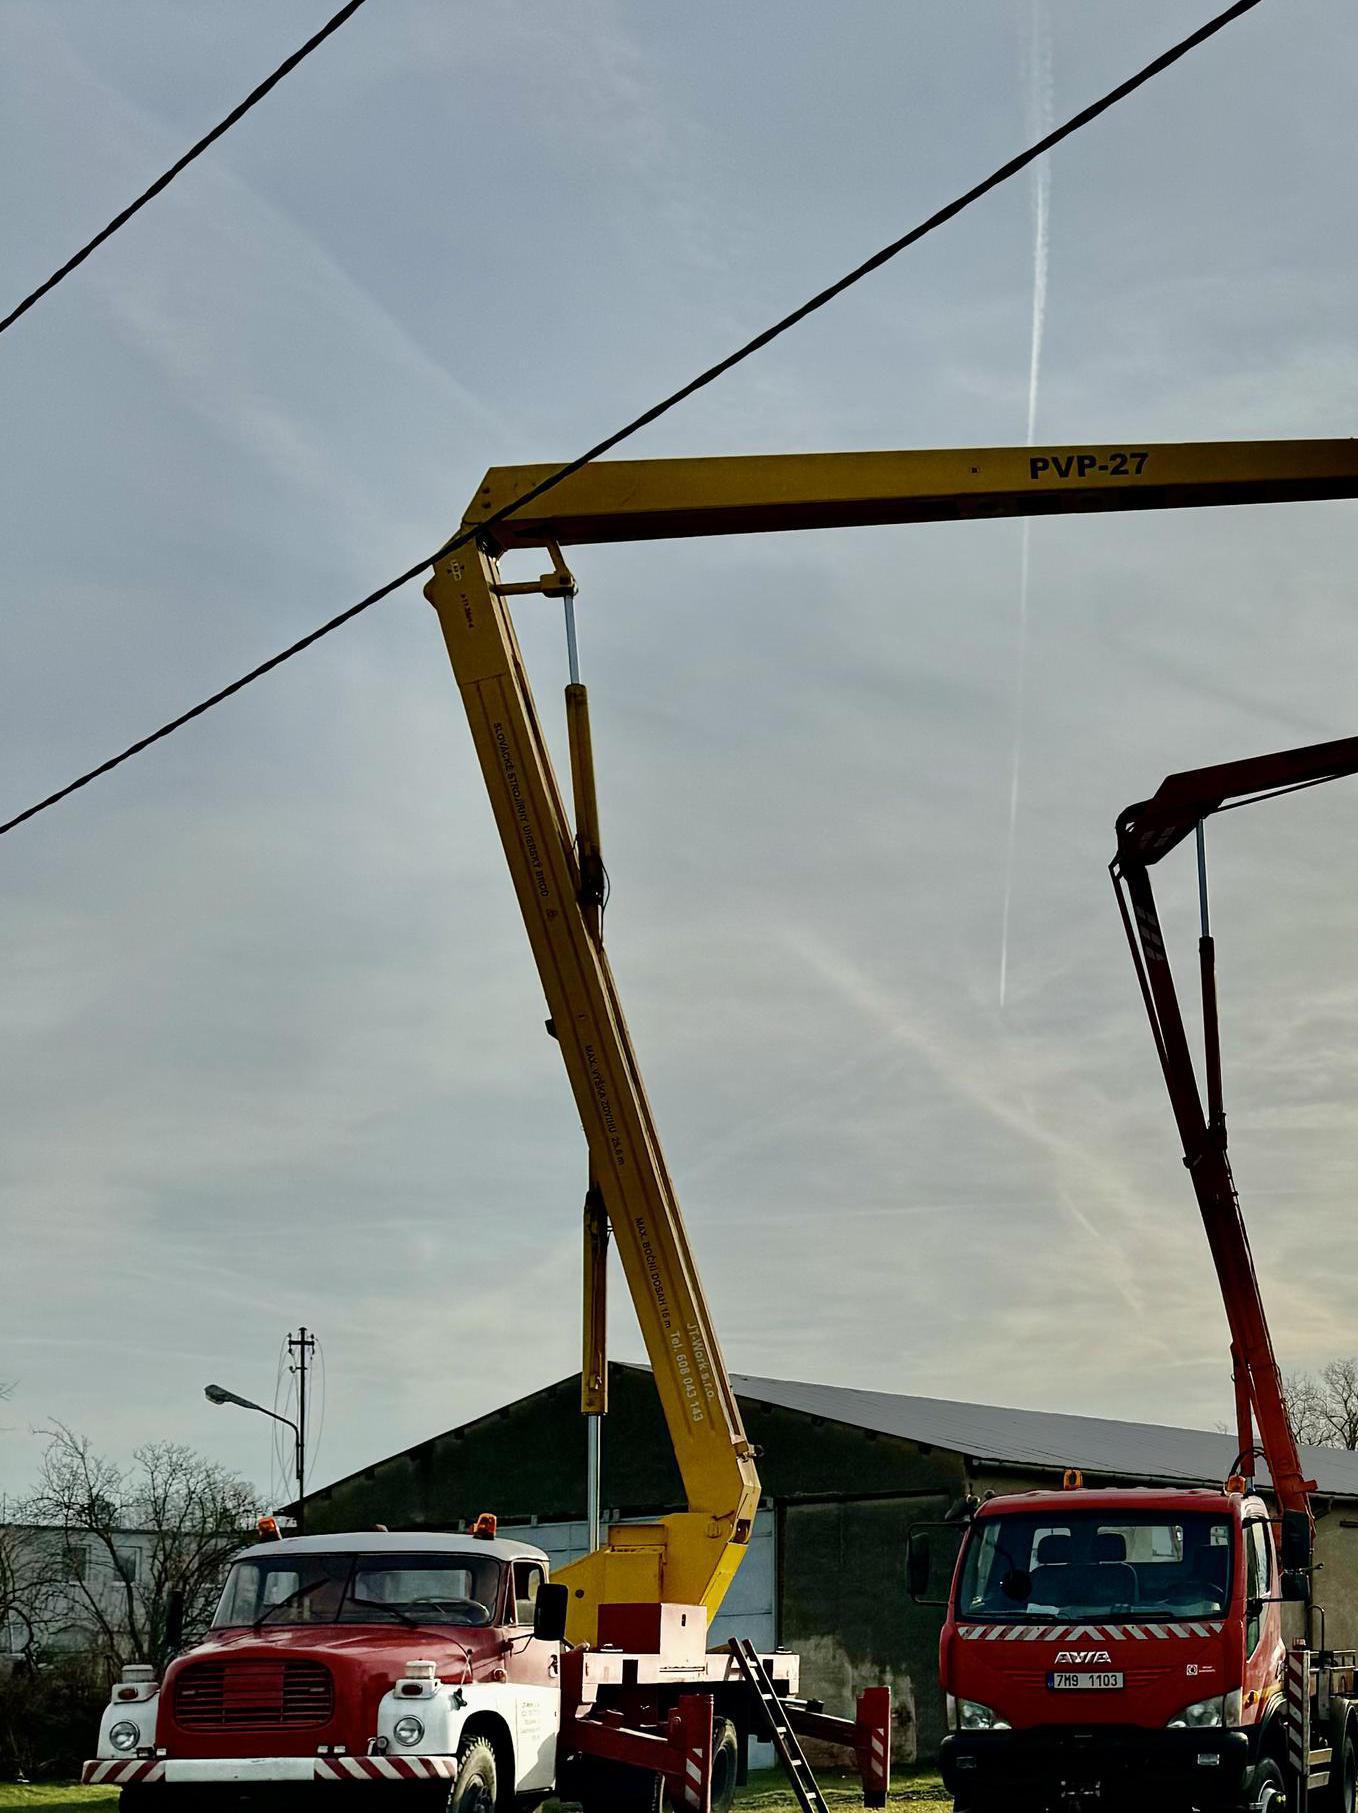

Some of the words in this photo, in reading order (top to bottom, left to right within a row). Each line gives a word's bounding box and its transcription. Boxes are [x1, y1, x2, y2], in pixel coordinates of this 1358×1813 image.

[1029, 452, 1149, 479] PVP-27
[669, 1329, 683, 1353] Tel.
[674, 1352, 690, 1376] 608
[686, 1321, 709, 1371] JT-Work
[700, 1370, 717, 1402] s.r.o.
[681, 1375, 697, 1400] 043
[689, 1400, 704, 1423] 143
[1054, 1651, 1112, 1664] AVIA
[1056, 1674, 1079, 1687] 7M9
[1088, 1674, 1118, 1687] 1103
